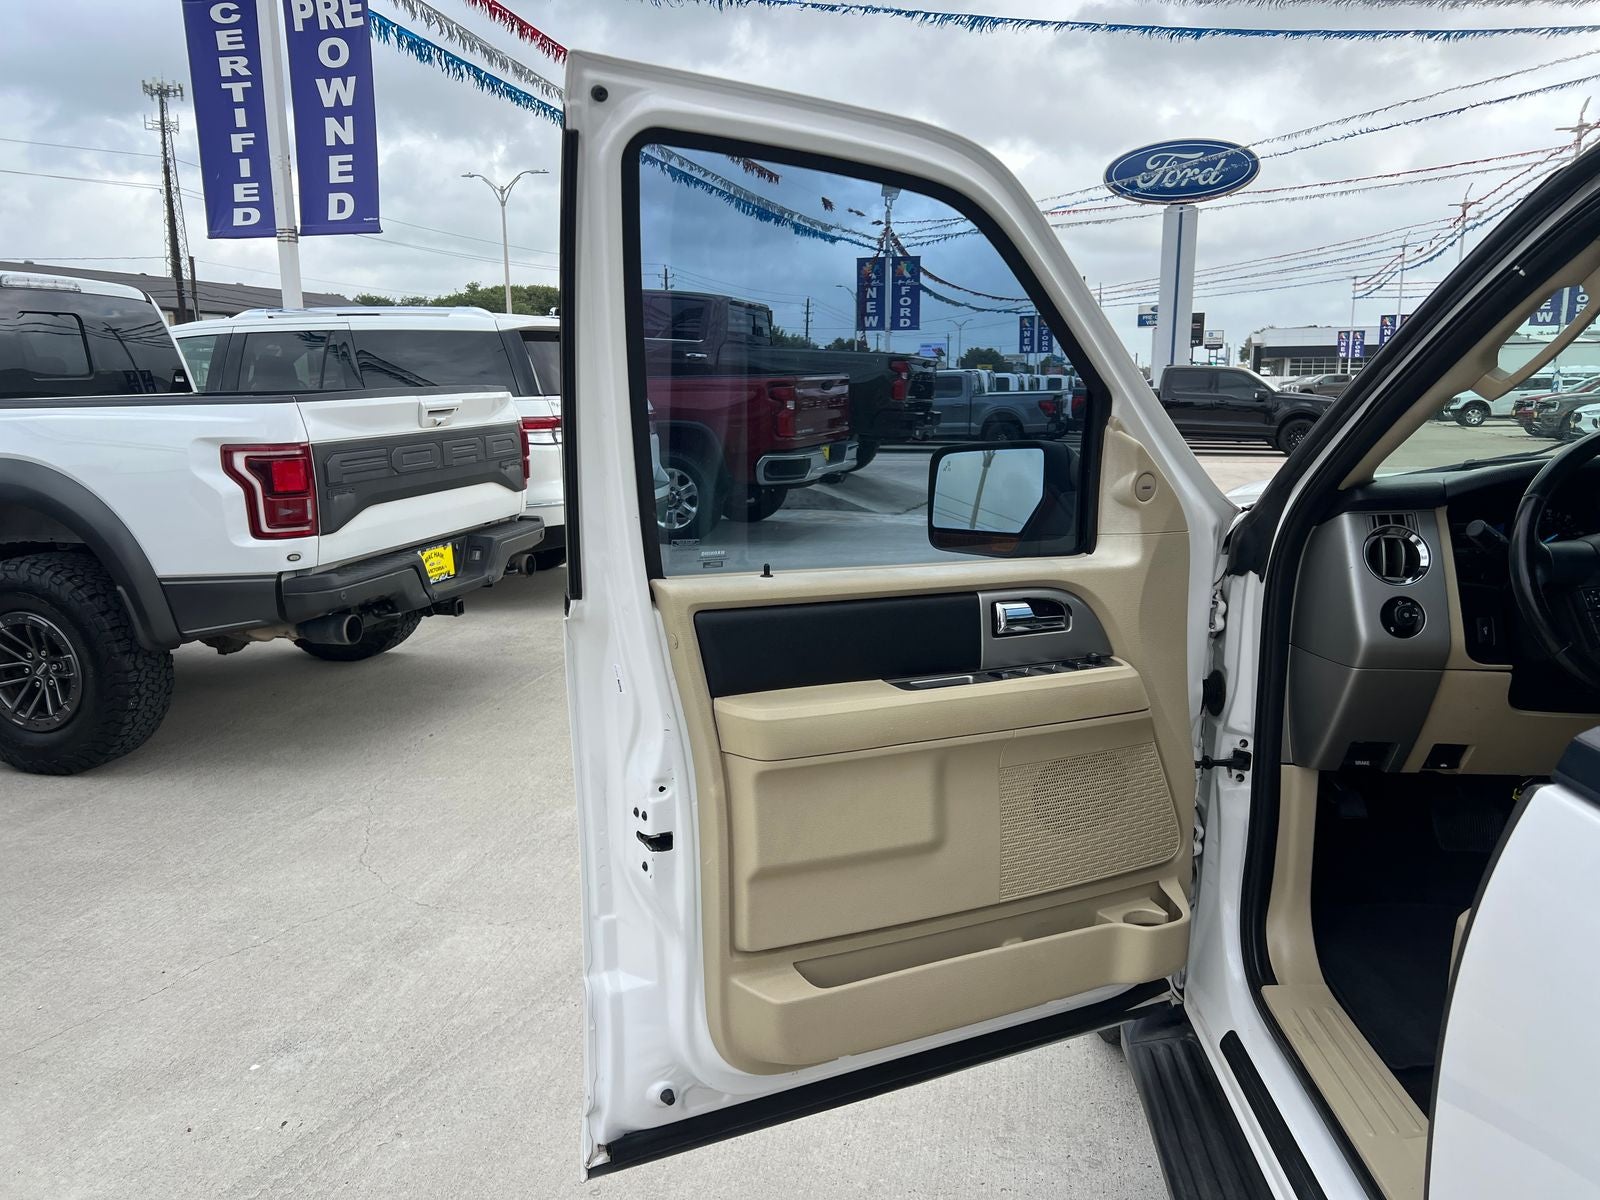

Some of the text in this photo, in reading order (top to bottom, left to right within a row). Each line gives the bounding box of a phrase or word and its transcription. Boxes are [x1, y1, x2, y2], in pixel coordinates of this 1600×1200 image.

[291, 0, 365, 32] PRE
[209, 2, 261, 227] CERTIFIED
[315, 36, 357, 221] OWNED
[1136, 151, 1226, 189] Ford
[864, 286, 879, 328] NEW
[899, 286, 912, 328] FORD
[1022, 330, 1031, 352] NEW
[1041, 329, 1049, 352] FORD
[1339, 341, 1347, 358] NEW
[325, 433, 520, 486] FORD
